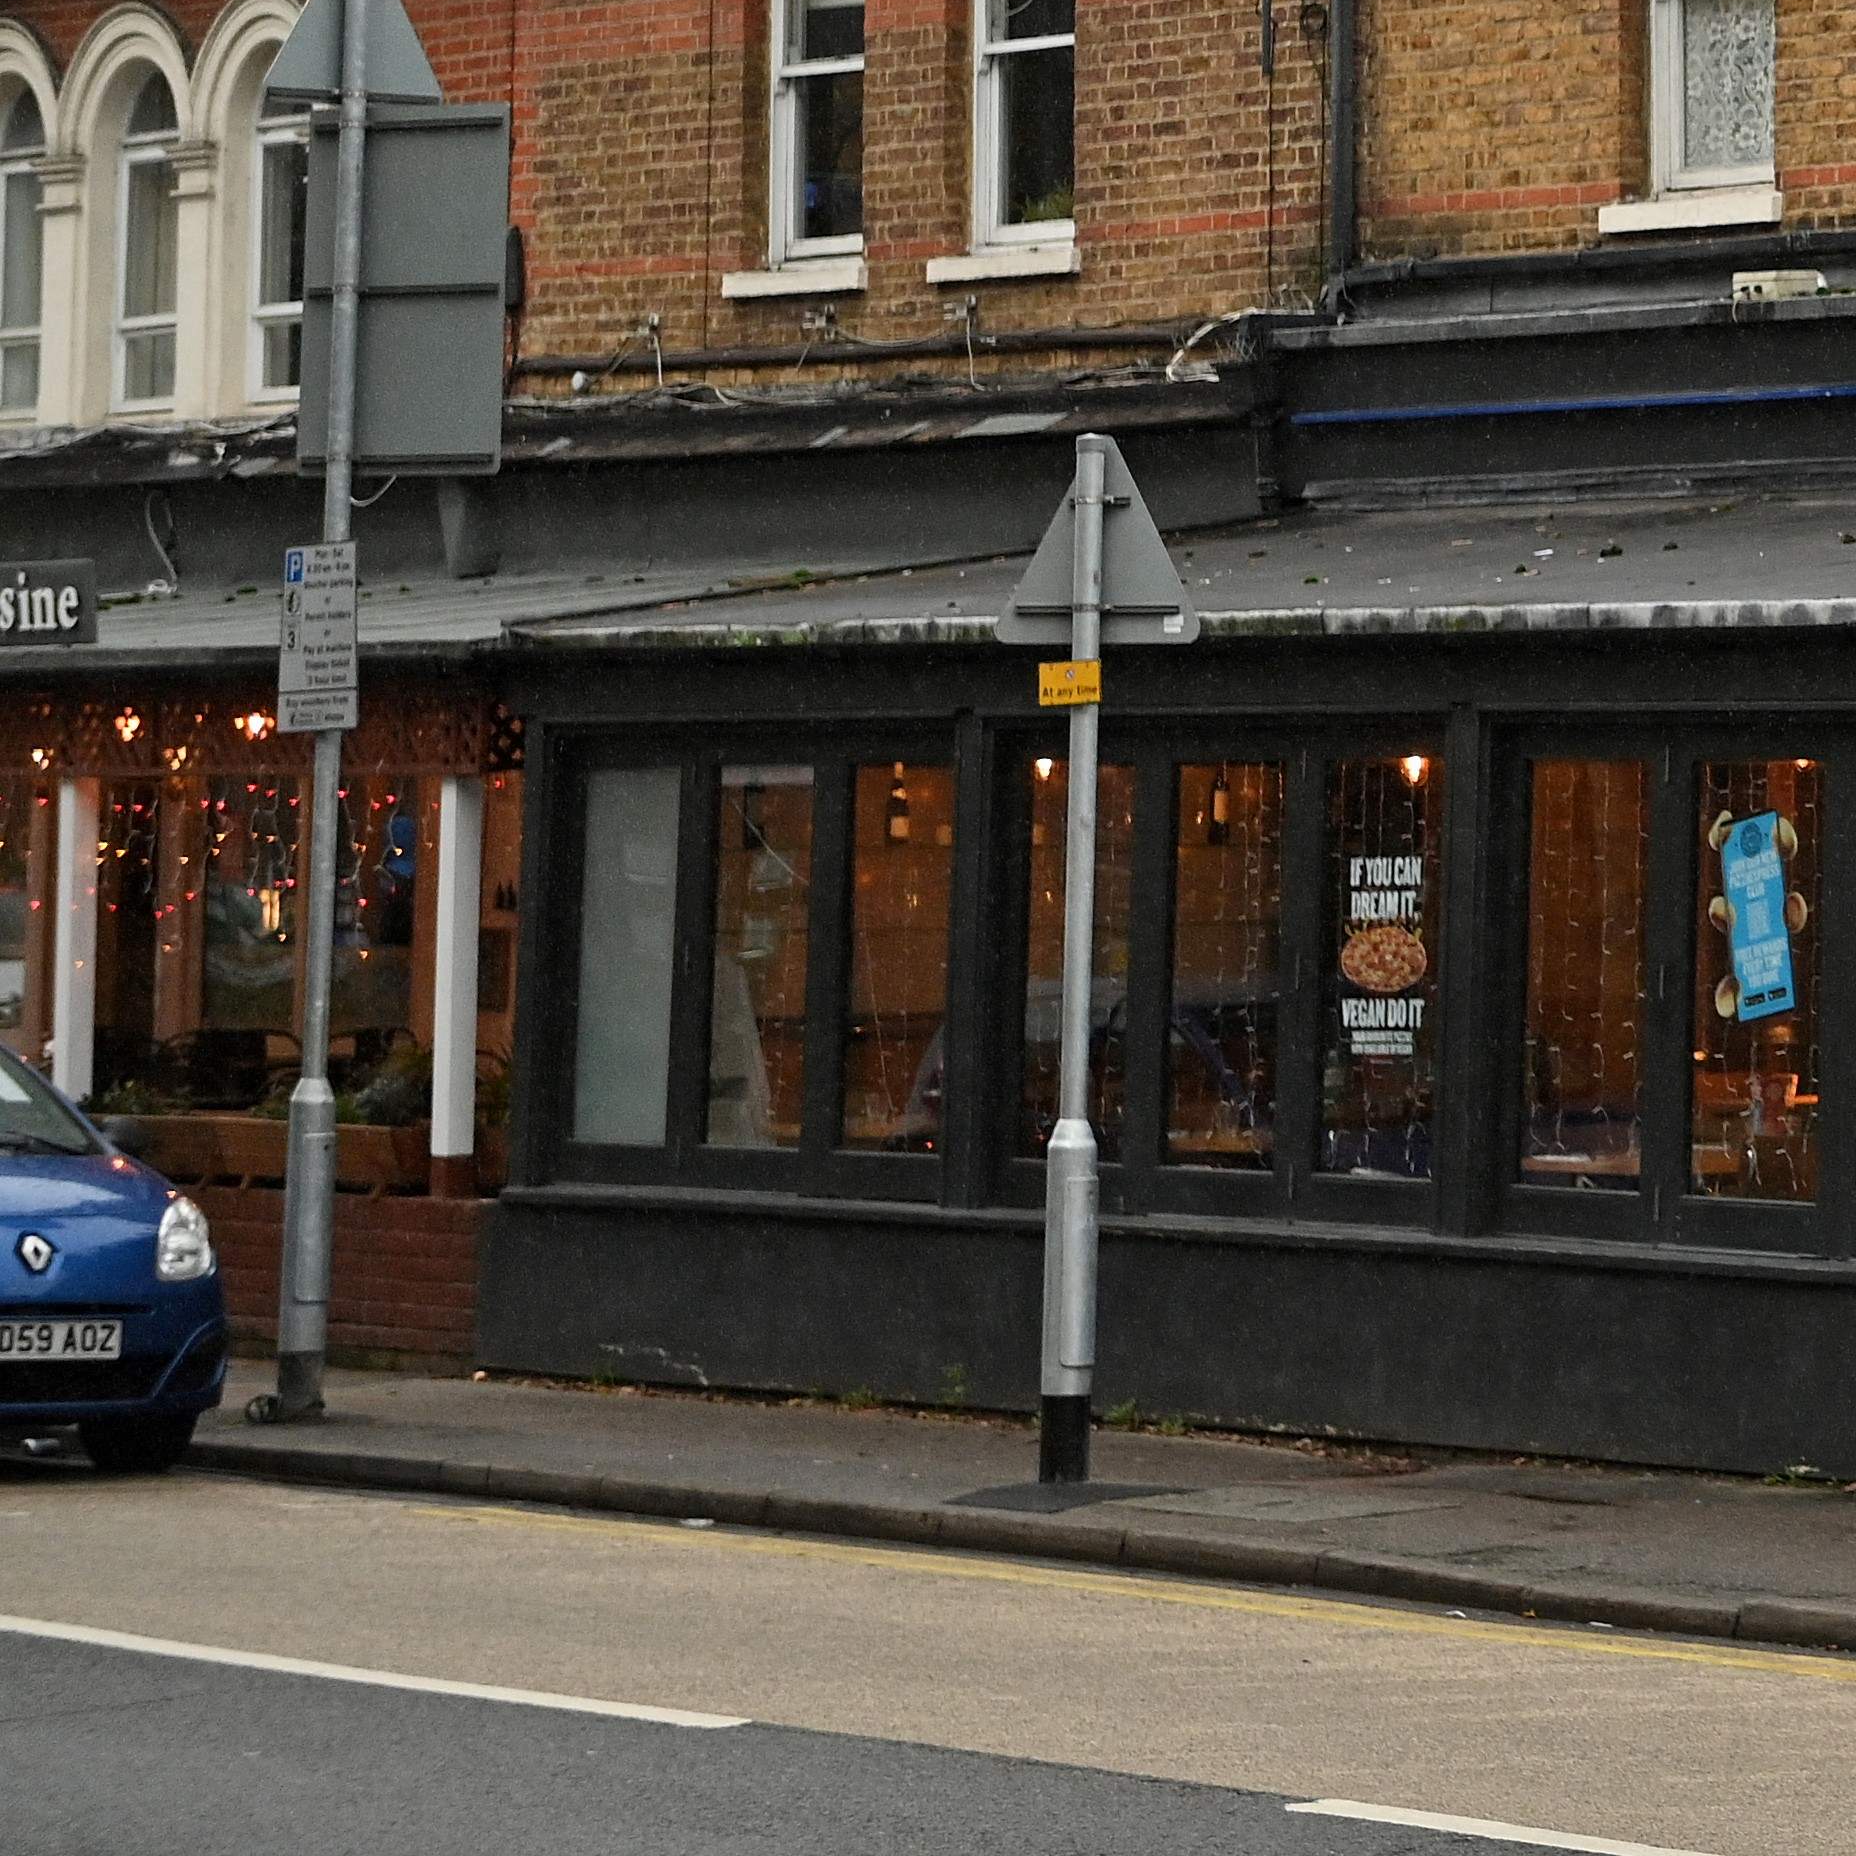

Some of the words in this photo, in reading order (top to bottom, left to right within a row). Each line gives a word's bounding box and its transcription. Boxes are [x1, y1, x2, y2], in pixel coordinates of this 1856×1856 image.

[0, 571, 79, 630] sine
[287, 630, 296, 649] 3
[1042, 687, 1054, 697] At
[1056, 687, 1073, 699] any
[1076, 685, 1100, 696] time
[1350, 857, 1363, 886] IF
[1365, 857, 1392, 886] YOU
[1394, 856, 1422, 886] CAN
[1351, 891, 1399, 920] DREAM
[1342, 998, 1385, 1028] VEGAN
[1387, 998, 1406, 1028] DO
[1408, 998, 1425, 1029] IT
